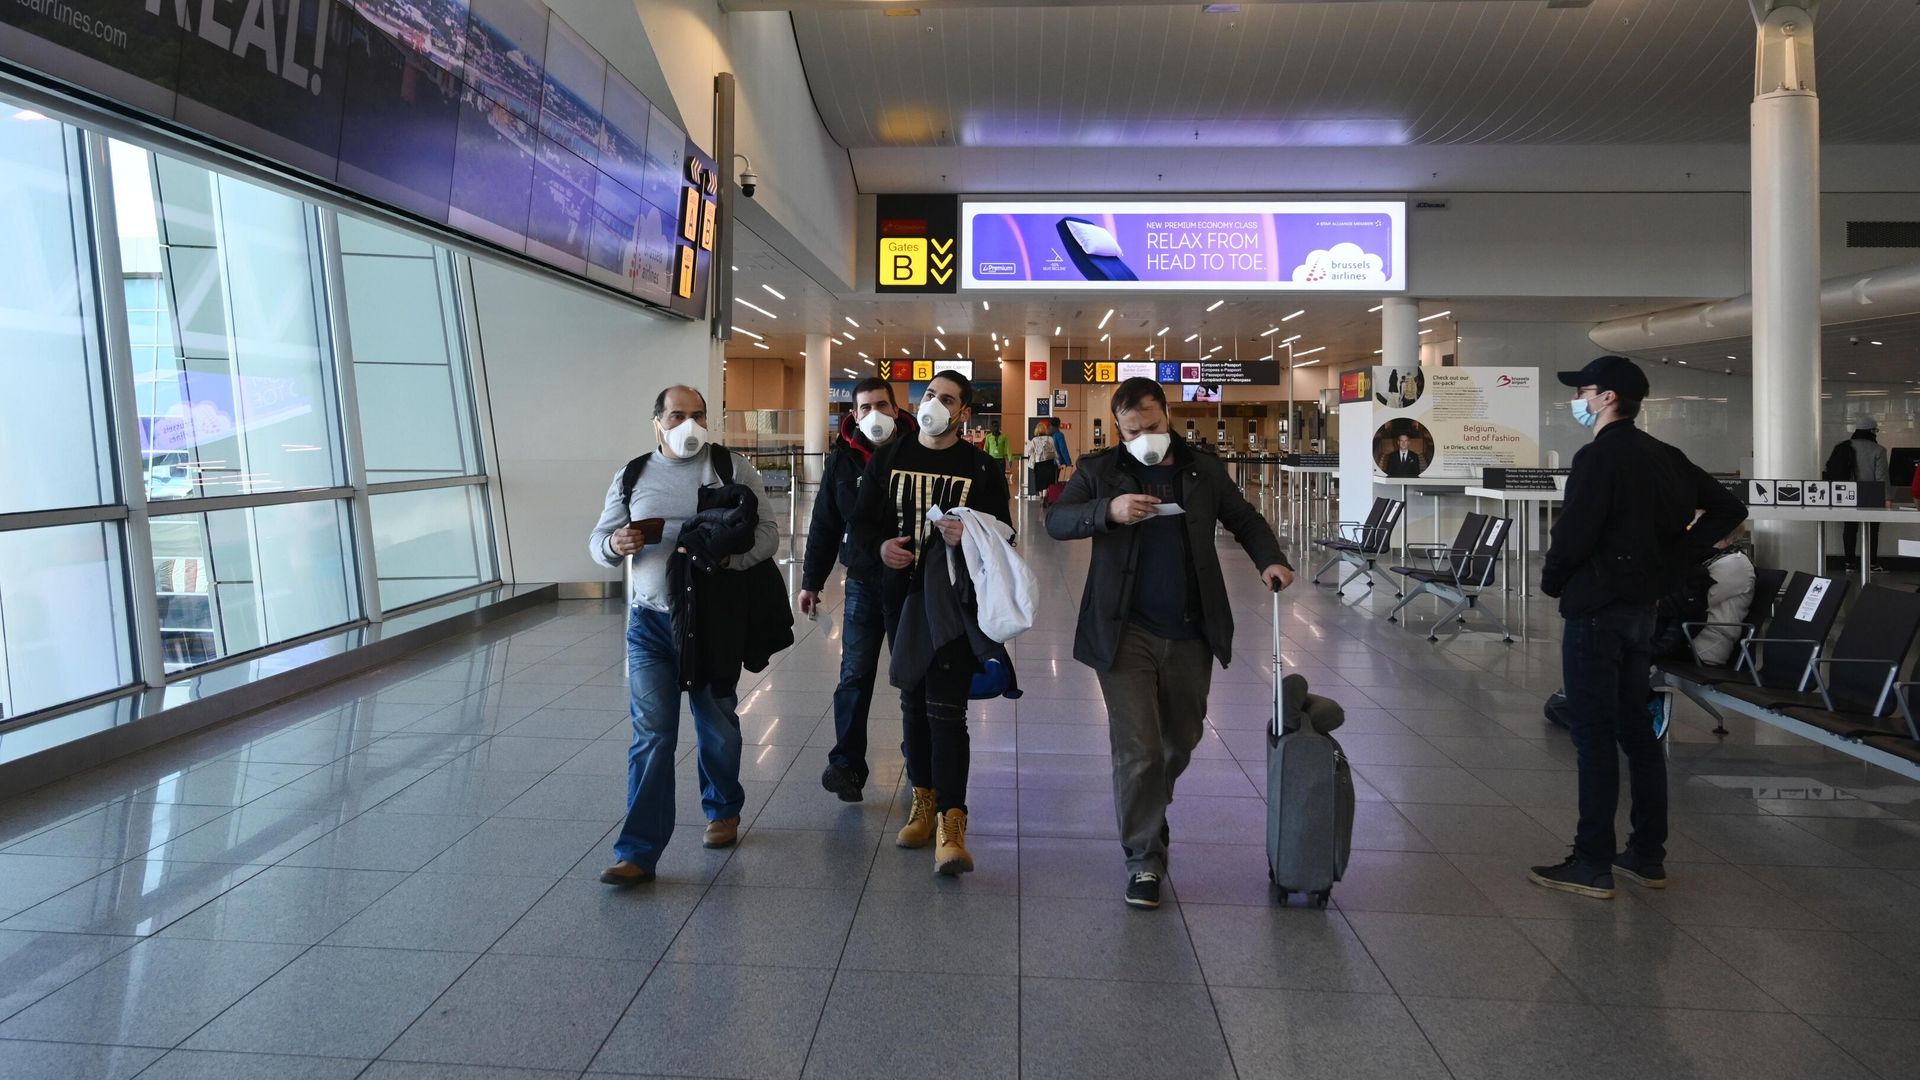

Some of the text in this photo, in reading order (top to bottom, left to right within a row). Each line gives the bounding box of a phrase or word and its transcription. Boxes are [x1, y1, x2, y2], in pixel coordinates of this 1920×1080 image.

[145, 0, 323, 97] EAL!
[687, 207, 696, 238] A
[704, 219, 712, 246] B
[1146, 232, 1258, 249] RELAX FROM
[888, 242, 919, 252] Gates
[893, 255, 913, 281] B
[988, 264, 1013, 272] Premium
[1146, 253, 1268, 271] HEAD TO TOE.
[1331, 260, 1371, 269] brussels
[684, 264, 691, 293] T
[1331, 271, 1367, 281] airlines
[918, 367, 927, 379] B
[1101, 369, 1110, 380] B
[1463, 425, 1497, 433] Belgium,
[1463, 434, 1520, 442] land of fashion
